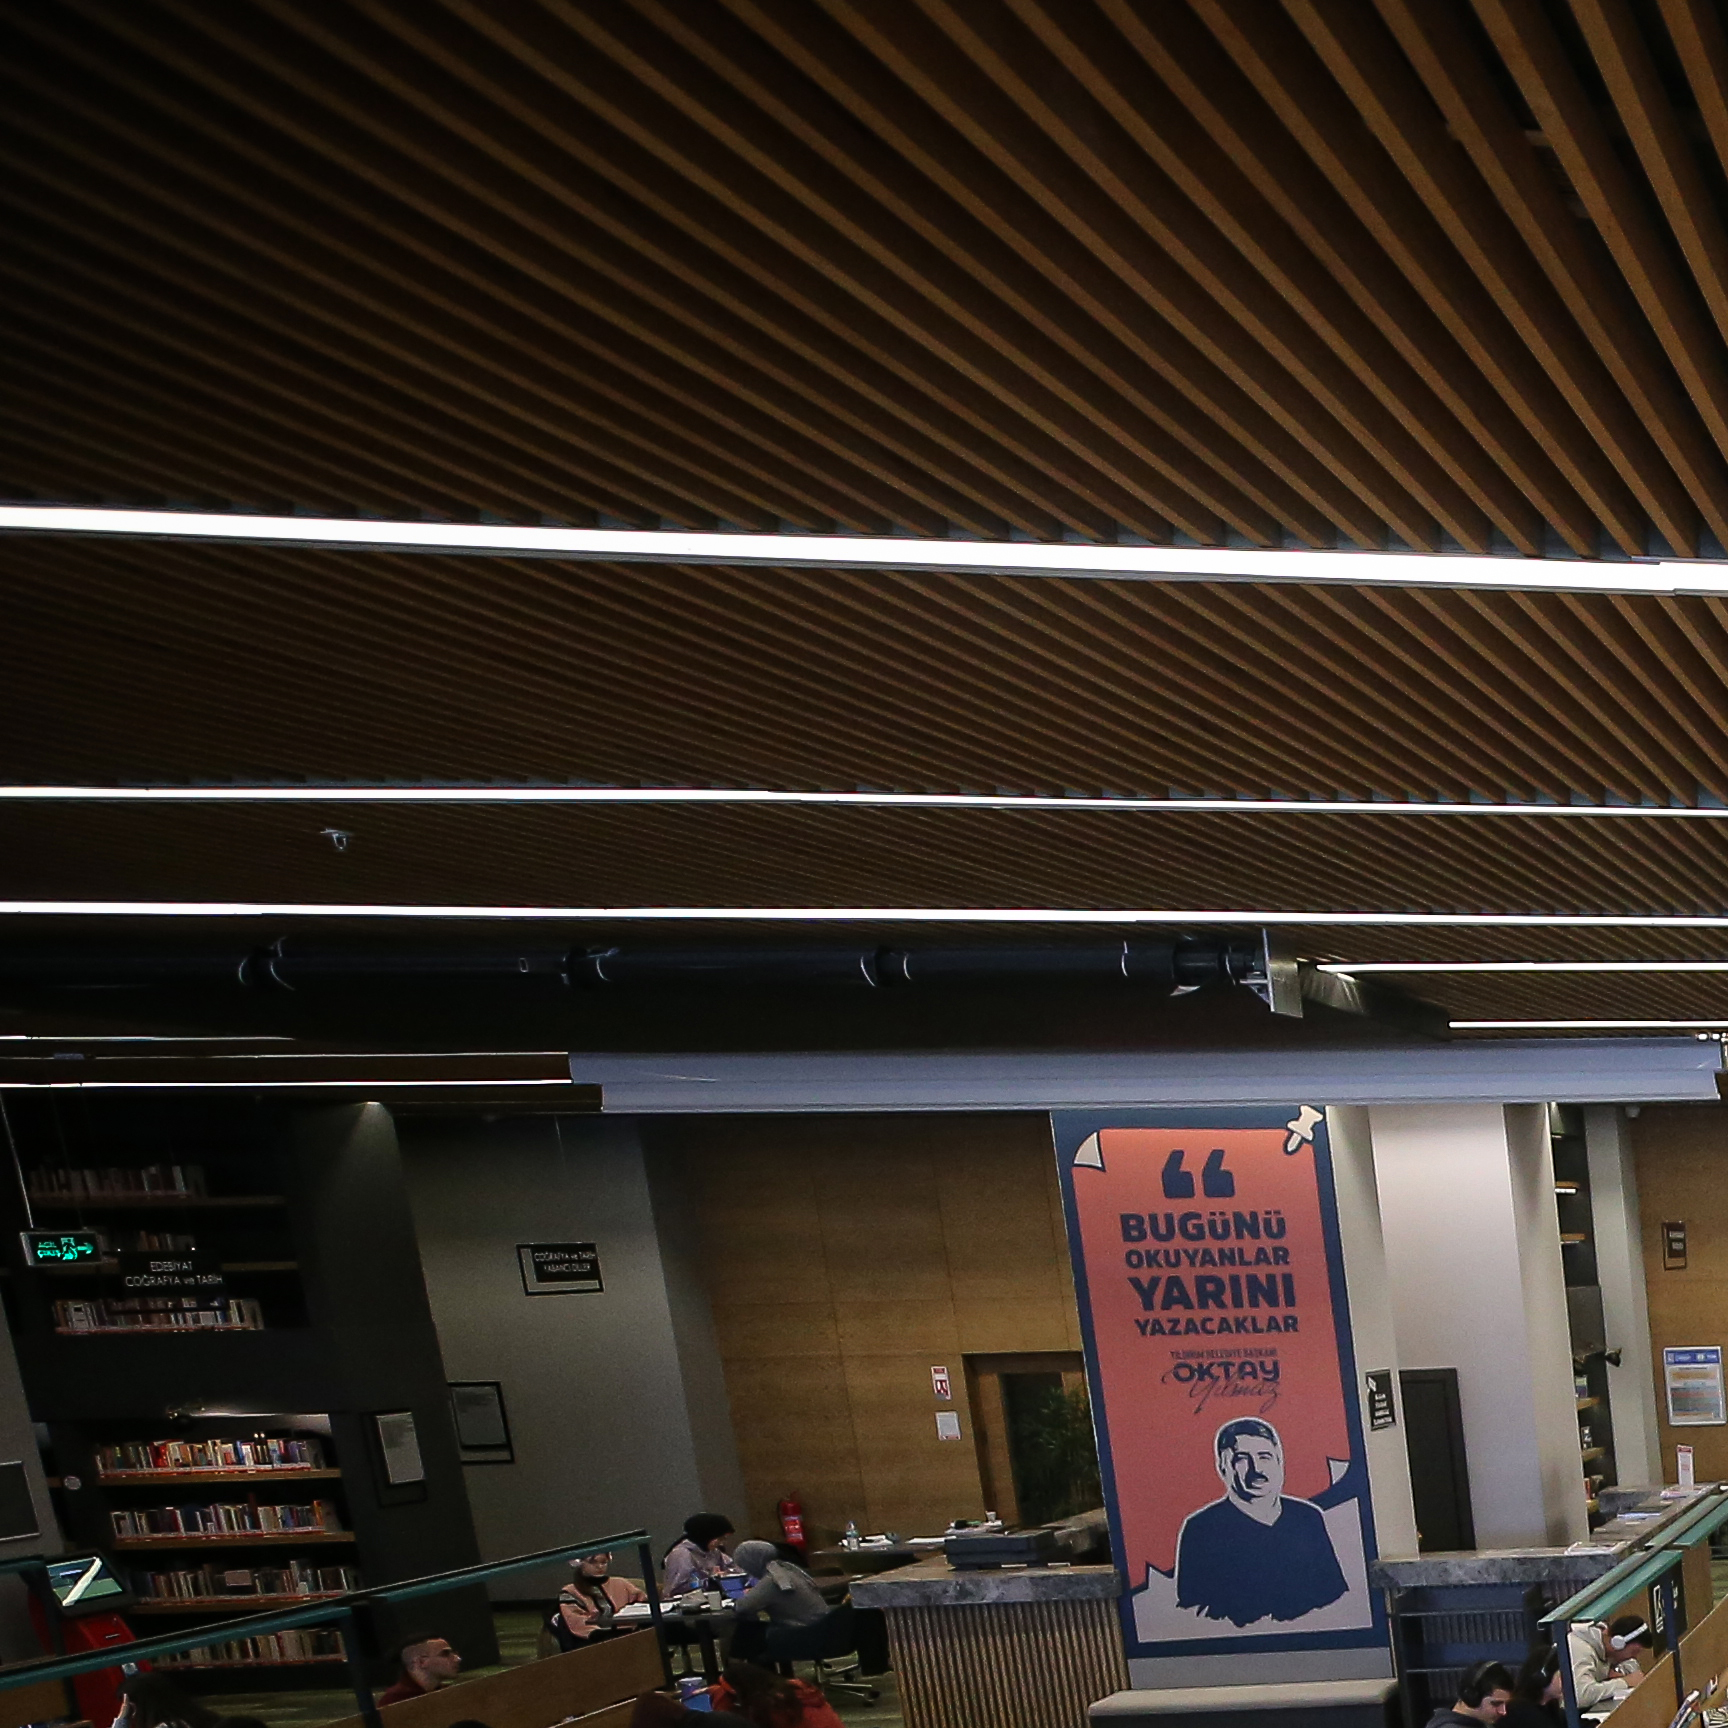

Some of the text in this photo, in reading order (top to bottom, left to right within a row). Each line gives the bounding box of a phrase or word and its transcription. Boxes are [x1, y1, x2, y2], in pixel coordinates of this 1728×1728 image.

[1120, 1210, 1287, 1242] BUGÜNÜ
[150, 1260, 193, 1272] EDEBİYAT
[1125, 1246, 1290, 1269] OKUYANLAR
[125, 1274, 181, 1287] COĞRAFYA
[1127, 1273, 1296, 1311] YARINI
[1134, 1315, 1299, 1336] YAZACAKLAR
[1173, 1360, 1280, 1382] OKTAY
